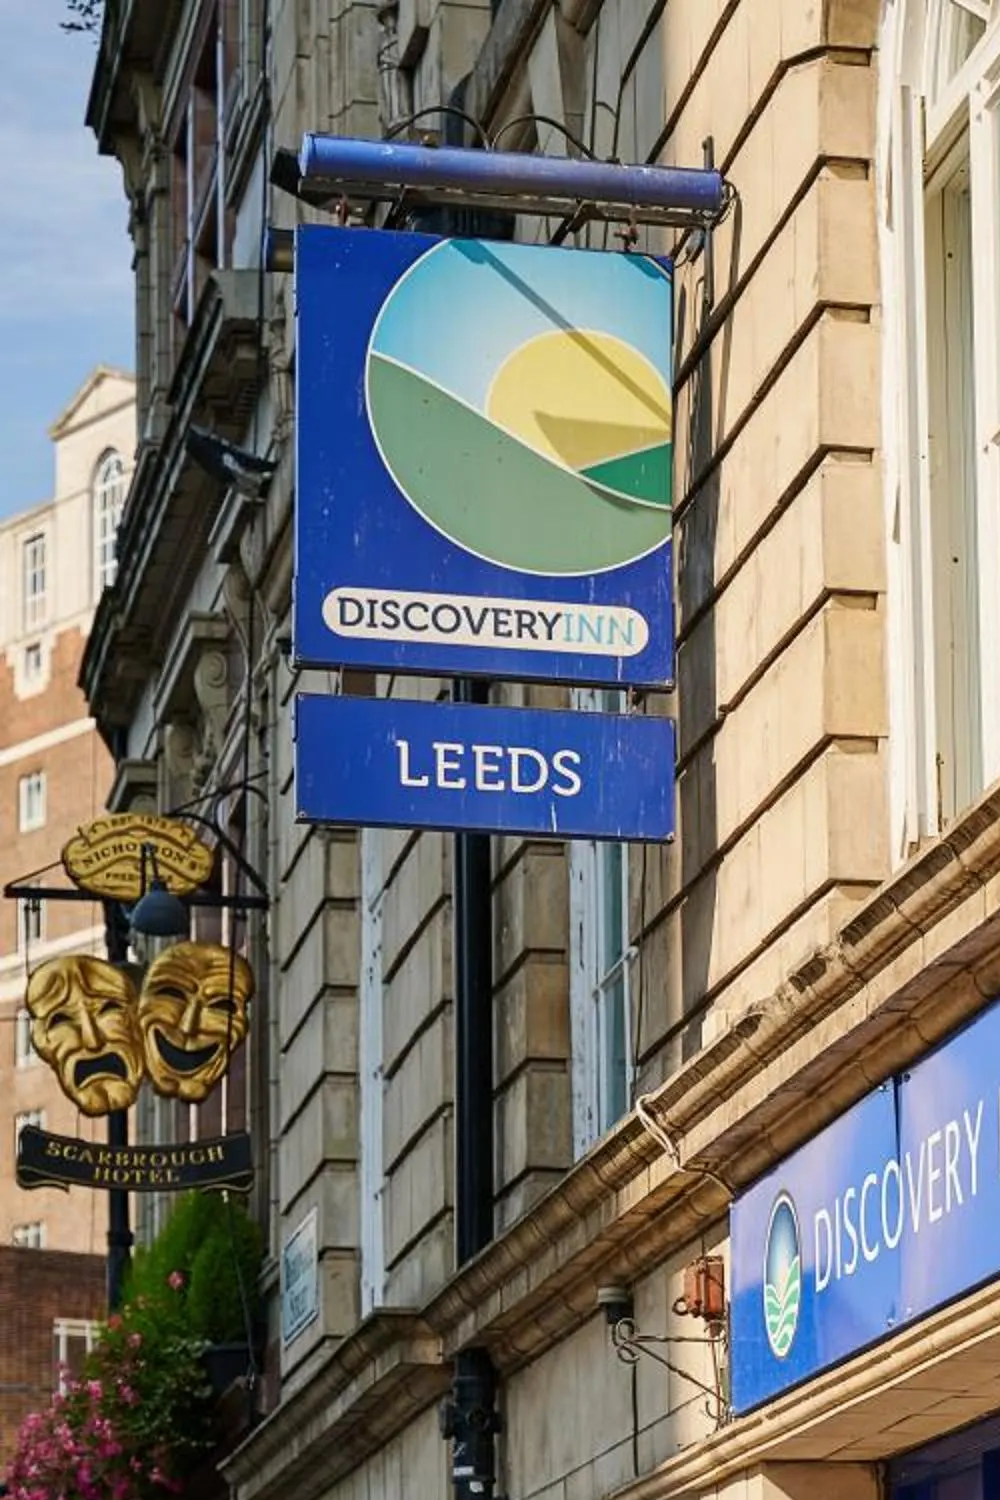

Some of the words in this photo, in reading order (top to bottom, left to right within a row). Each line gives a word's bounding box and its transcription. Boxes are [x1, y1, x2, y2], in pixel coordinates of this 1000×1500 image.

[396, 740, 581, 797] LEEDS
[82, 840, 199, 870] NICHOON'S
[46, 1142, 225, 1168] SCARBROUGH
[93, 1167, 180, 1185] HOTEL
[814, 1100, 983, 1293] DISCOVERY
